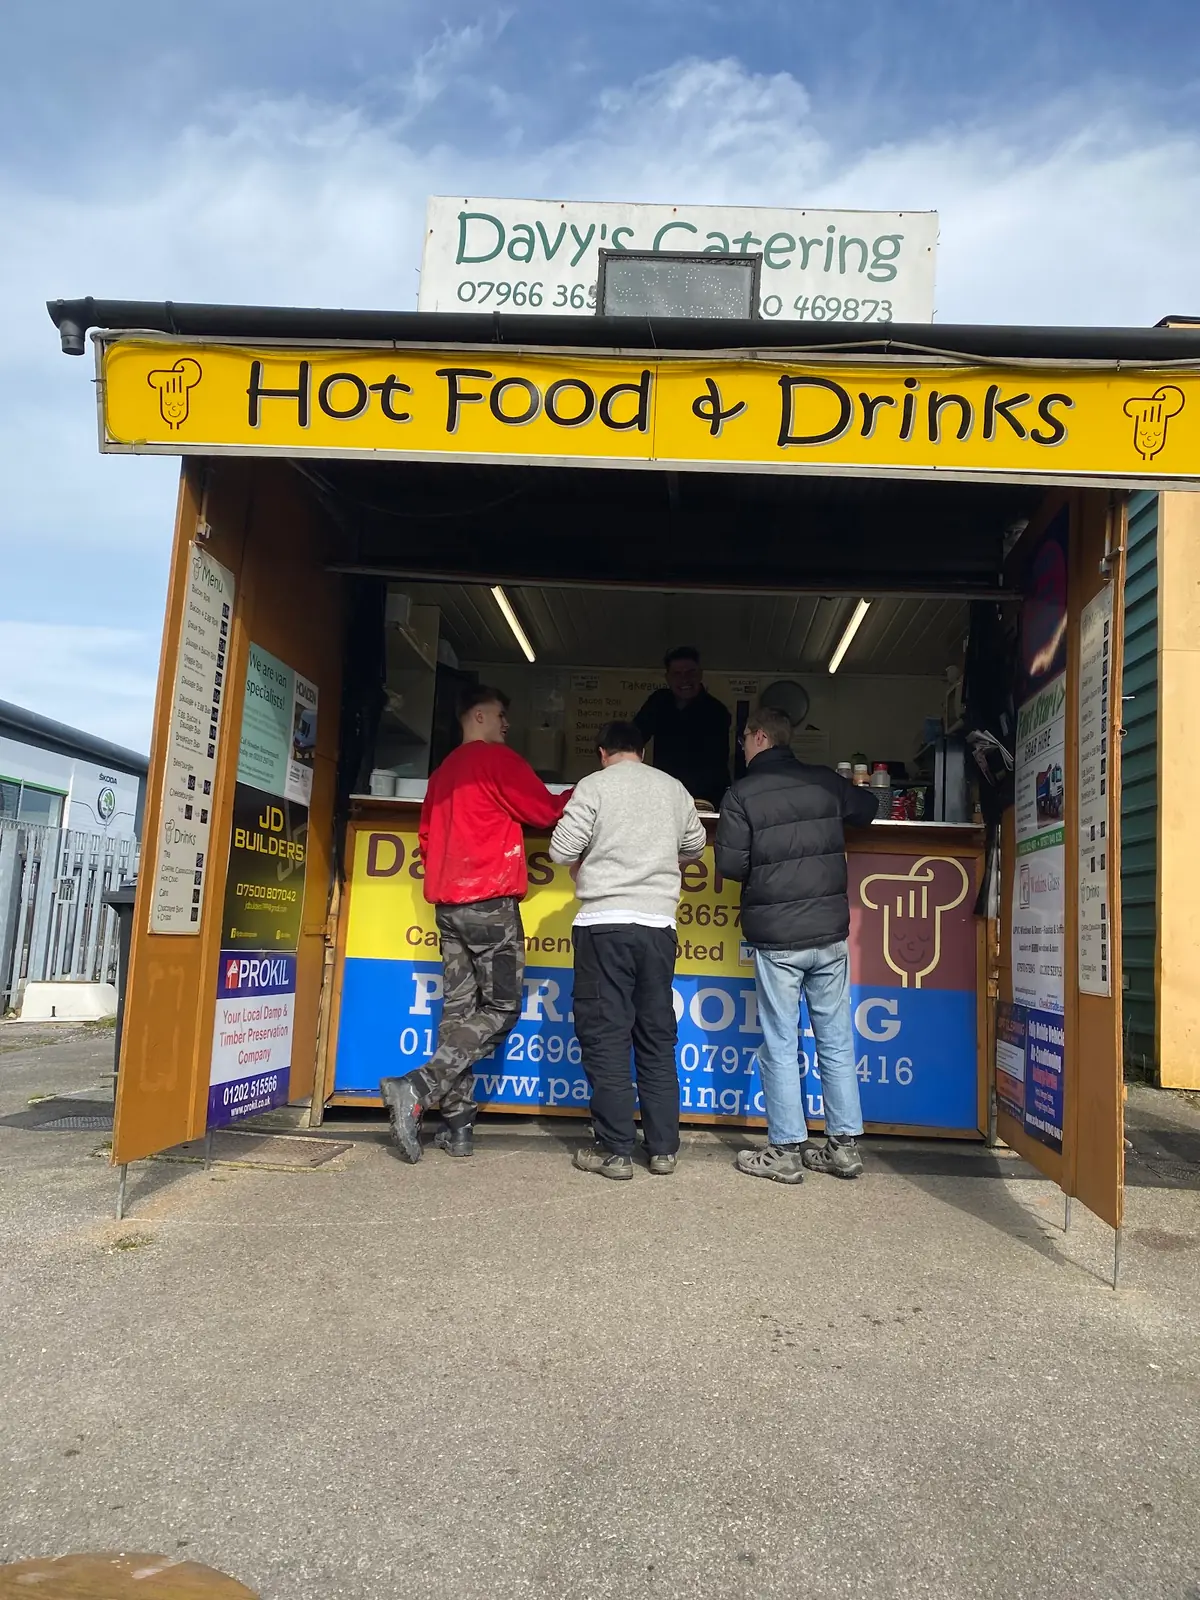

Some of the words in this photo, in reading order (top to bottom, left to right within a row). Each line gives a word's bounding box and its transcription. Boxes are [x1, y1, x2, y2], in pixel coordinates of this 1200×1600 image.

[455, 211, 635, 267] Davy's
[457, 280, 544, 309] 07966
[793, 294, 893, 323] 469873
[246, 360, 413, 428] Hot
[435, 369, 653, 433] Food
[690, 377, 746, 437] &
[777, 374, 1076, 448] Drinks
[202, 566, 224, 593] Menu
[249, 650, 262, 671] We
[262, 664, 274, 679] are
[275, 672, 287, 688] van
[246, 679, 286, 711] specialists!
[259, 805, 284, 832] JD
[173, 827, 196, 848] Drinks
[234, 828, 304, 862] BUILDERS
[236, 883, 266, 899] 07500
[266, 887, 297, 902] 807042
[677, 903, 741, 928] 3657
[406, 925, 441, 947] Ca
[238, 959, 289, 988] PROKIL
[223, 1008, 241, 1025] Your
[242, 1004, 263, 1023] Local
[263, 1004, 282, 1022] Damp
[283, 1004, 288, 1017] &
[220, 1031, 246, 1047] Timber
[247, 1024, 289, 1042] Preservation
[238, 1048, 272, 1065] Company
[507, 1033, 582, 1065] 2696
[681, 1043, 759, 1075] 0797
[223, 1080, 249, 1106] 01202
[250, 1074, 278, 1099] 515566
